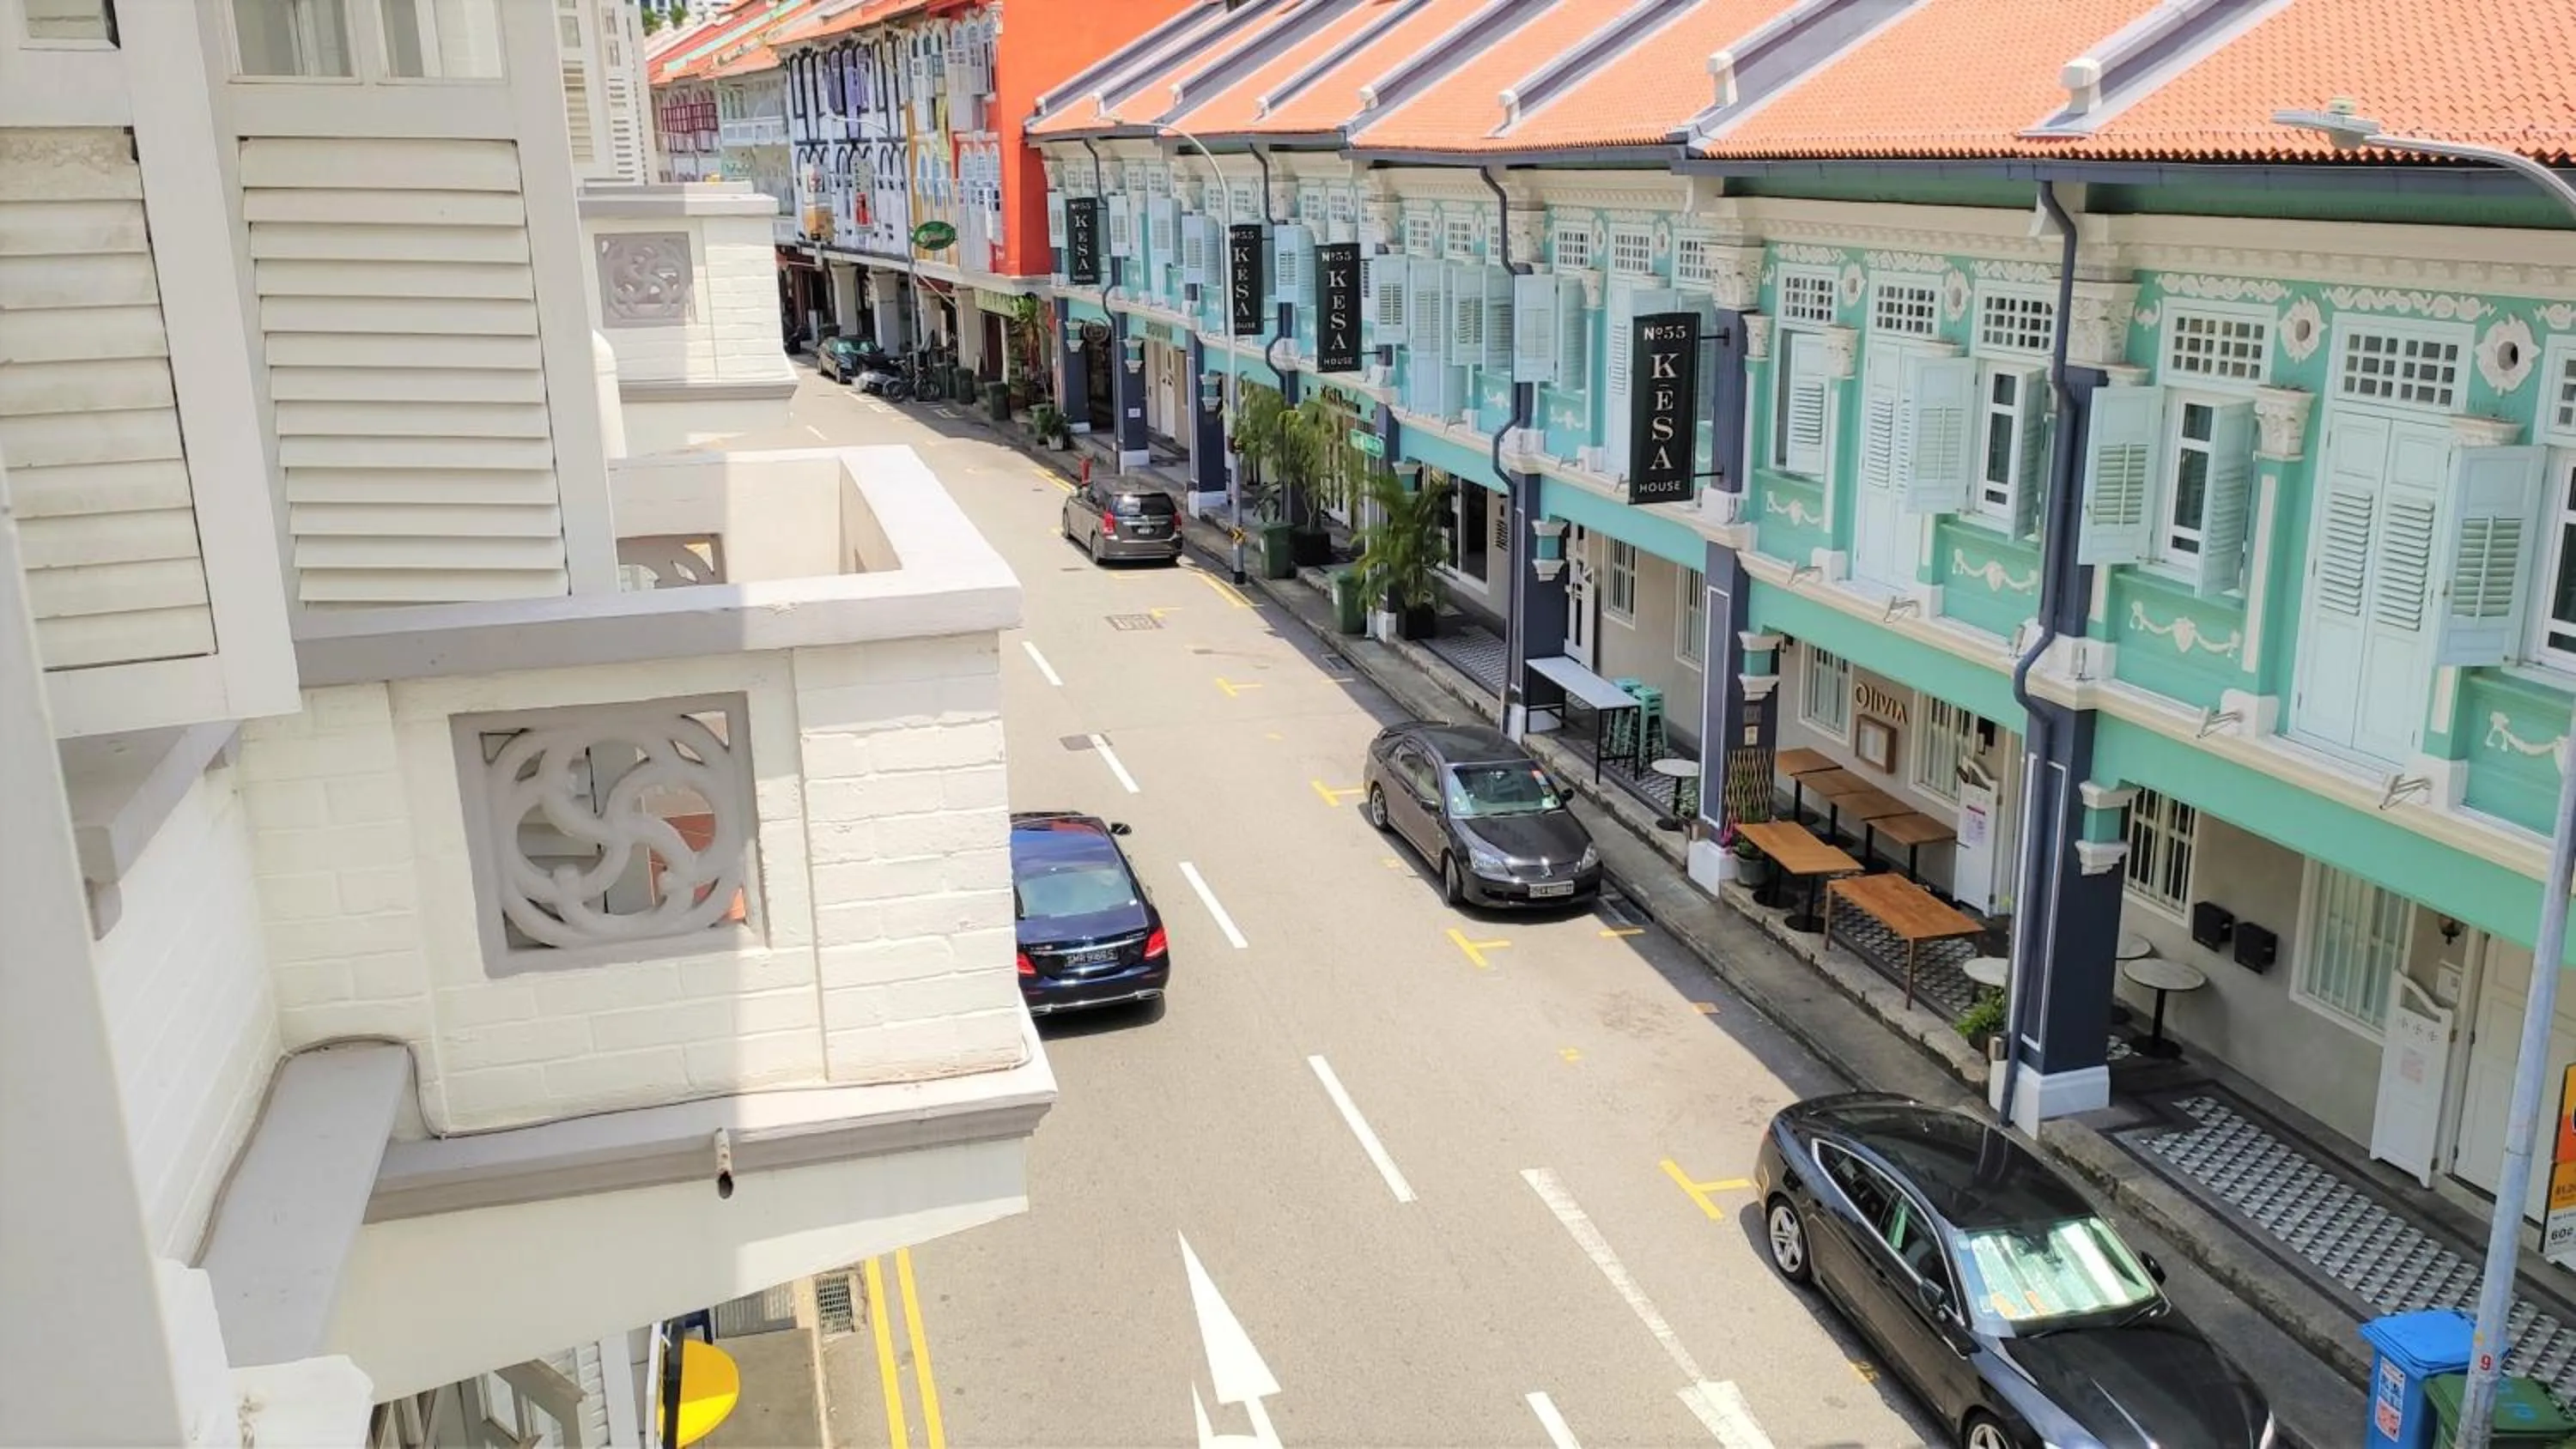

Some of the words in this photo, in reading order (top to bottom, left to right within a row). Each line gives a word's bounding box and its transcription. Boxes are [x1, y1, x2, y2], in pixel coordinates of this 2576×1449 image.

[1323, 356, 1353, 366] HOUSE
[1639, 480, 1681, 494] HOUSE
[2480, 1353, 2492, 1371] 9
